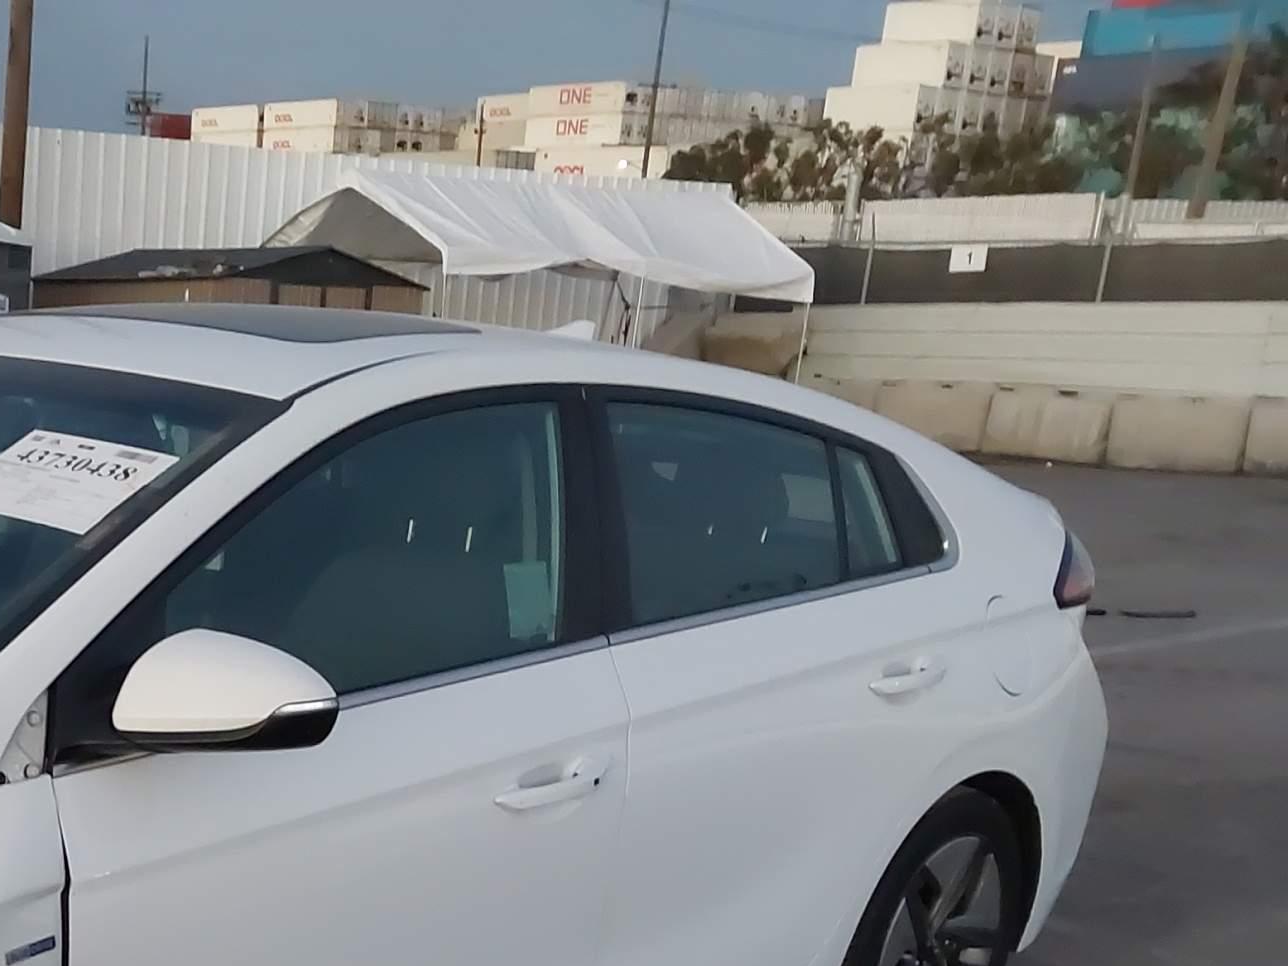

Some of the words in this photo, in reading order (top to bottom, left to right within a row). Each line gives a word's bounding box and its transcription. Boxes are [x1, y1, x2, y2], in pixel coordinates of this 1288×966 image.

[559, 87, 593, 105] ONE
[555, 119, 590, 136] ONE
[967, 251, 973, 265] 1
[16, 447, 138, 482] 43730438
